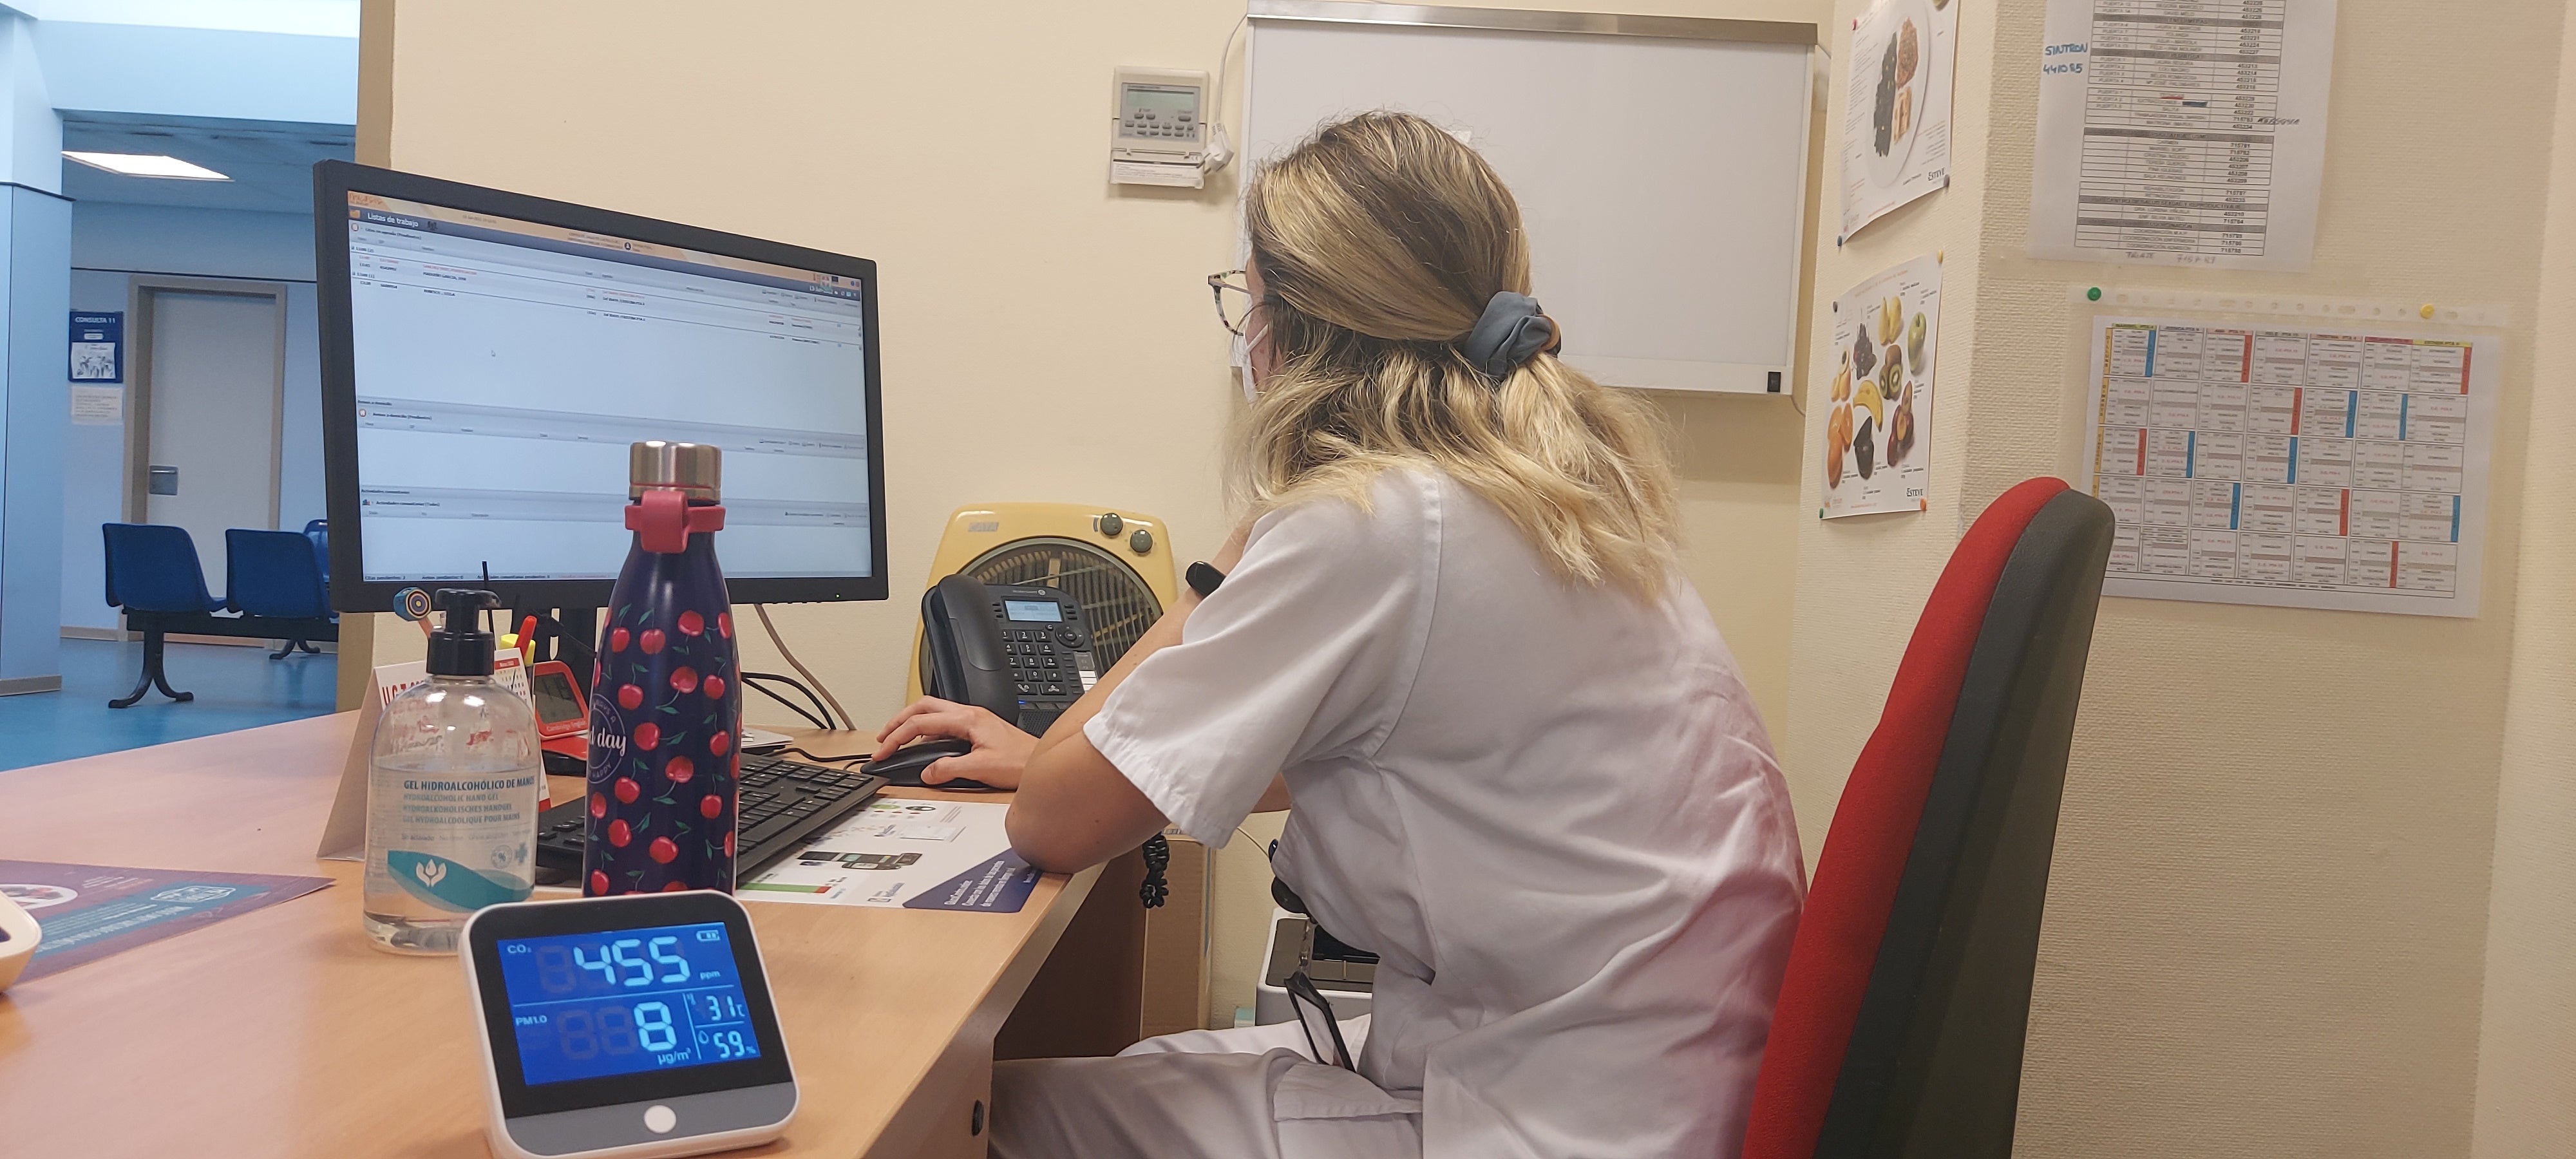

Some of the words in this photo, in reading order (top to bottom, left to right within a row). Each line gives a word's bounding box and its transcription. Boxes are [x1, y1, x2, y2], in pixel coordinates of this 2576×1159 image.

[2045, 42, 2088, 55] SINTRON
[368, 212, 386, 222] Listas
[387, 215, 395, 223] de
[397, 218, 419, 228] trabajo
[1906, 488, 1924, 497] ESTEVE
[597, 727, 627, 757] day
[592, 763, 612, 778] HAPPY
[404, 780, 419, 790] GEL
[421, 778, 504, 791] HIDROALCOHÓLICO
[506, 778, 515, 788] DE
[466, 793, 486, 802] HAND
[488, 793, 499, 801] GEL
[402, 815, 414, 824] GEL
[484, 814, 502, 823] POUR
[573, 936, 691, 987] 455
[700, 970, 721, 981] ppm
[706, 995, 736, 1021] 31
[516, 1014, 548, 1026] PM1.0
[634, 1001, 677, 1051] 8
[714, 1030, 746, 1059] 59
